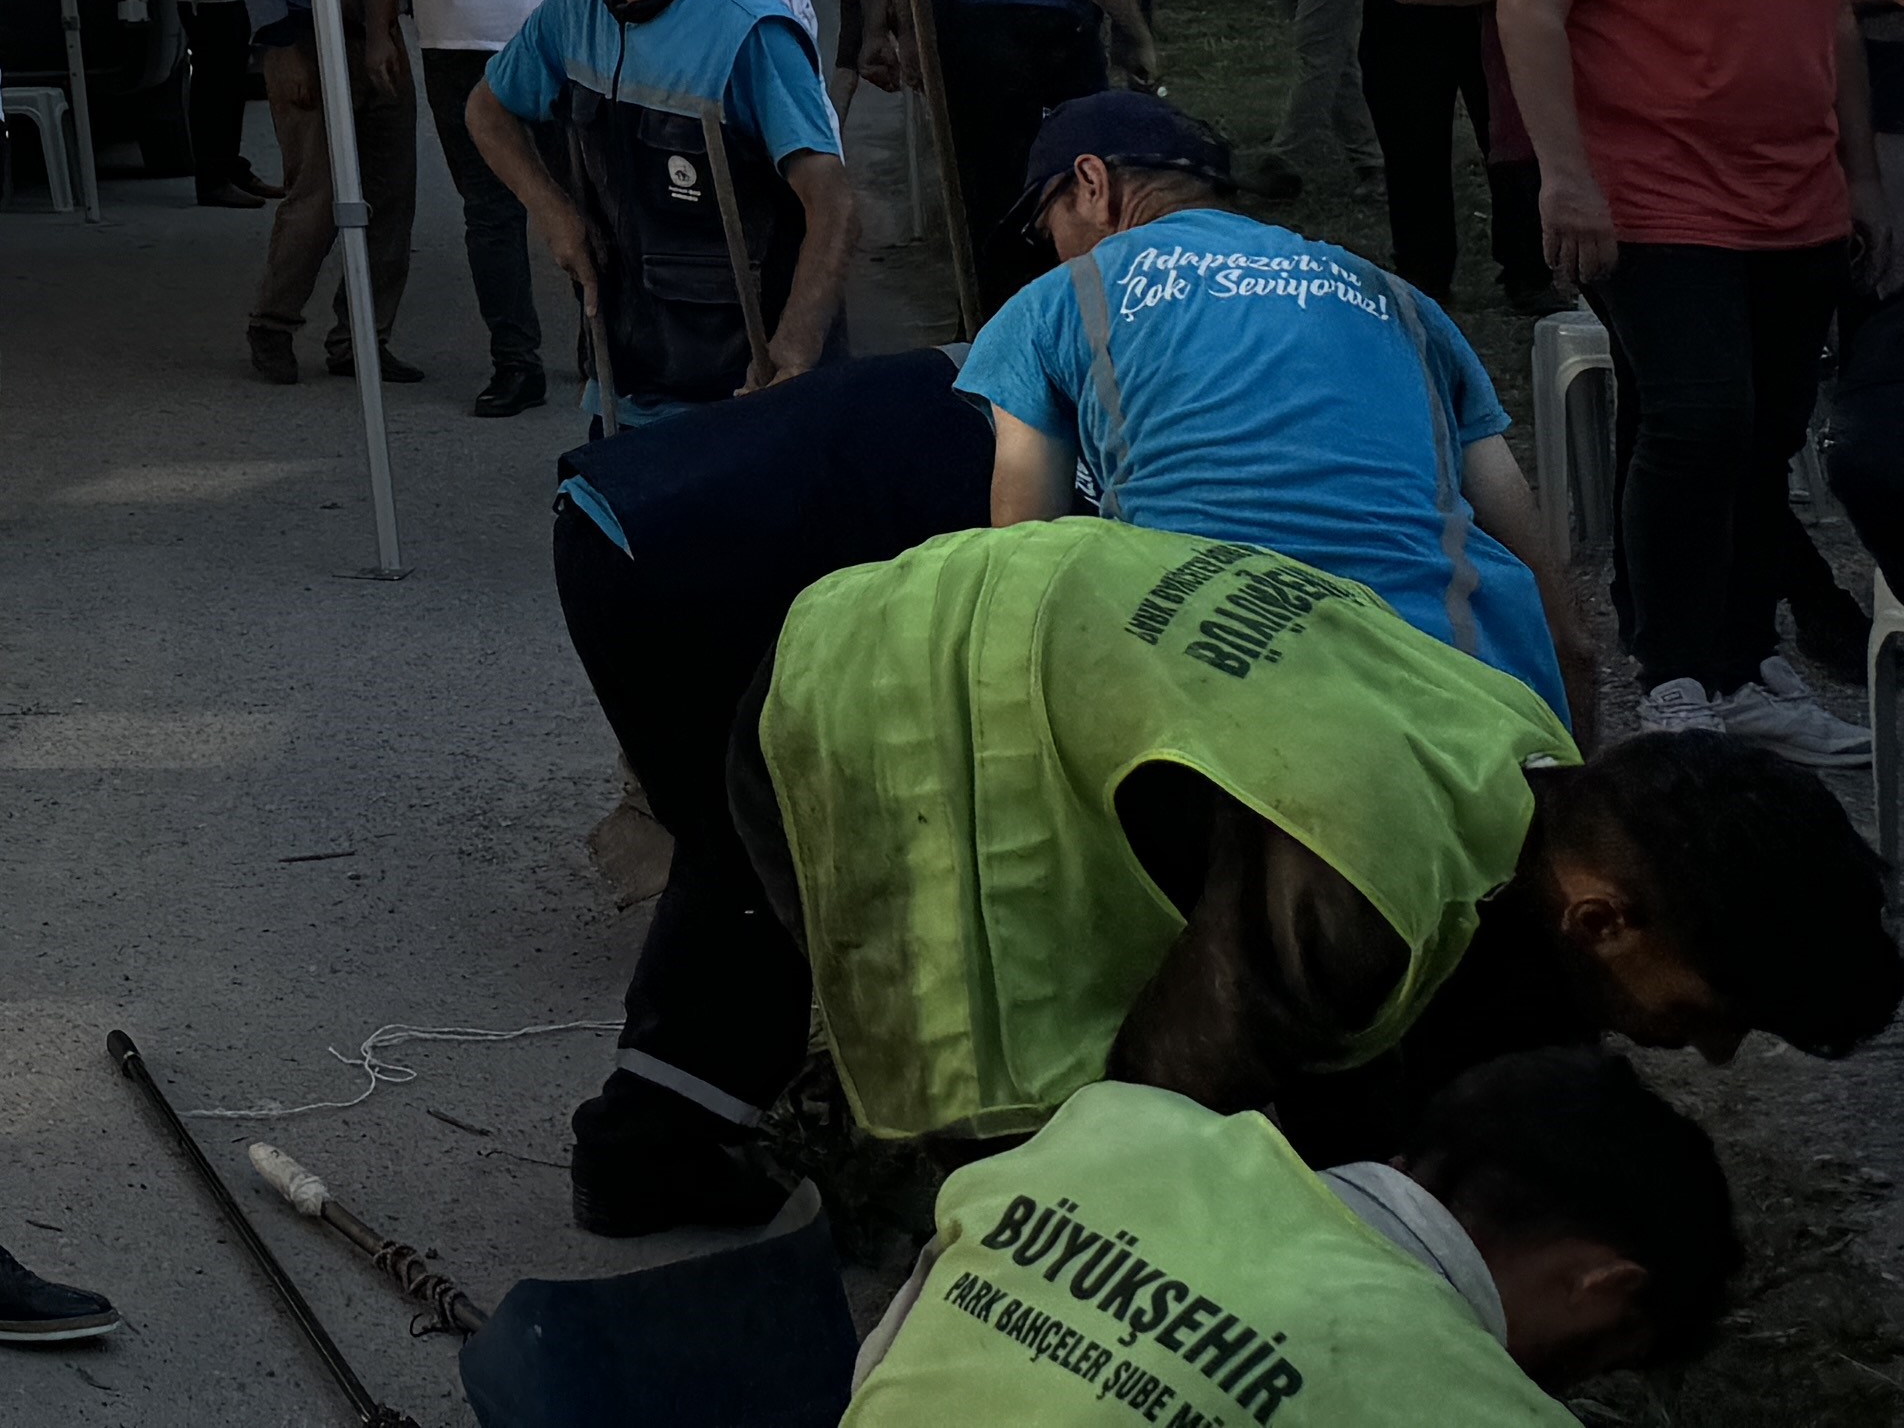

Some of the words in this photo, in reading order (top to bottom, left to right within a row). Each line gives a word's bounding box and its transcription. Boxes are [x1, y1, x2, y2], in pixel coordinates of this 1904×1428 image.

[1119, 269, 1191, 322] Çok
[943, 1271, 1008, 1324] PARK
[995, 1298, 1113, 1384] BAHÇELER
[1096, 1359, 1178, 1424] ŞUBE
[980, 1194, 1303, 1428] BÜYÜKŞEHİR
